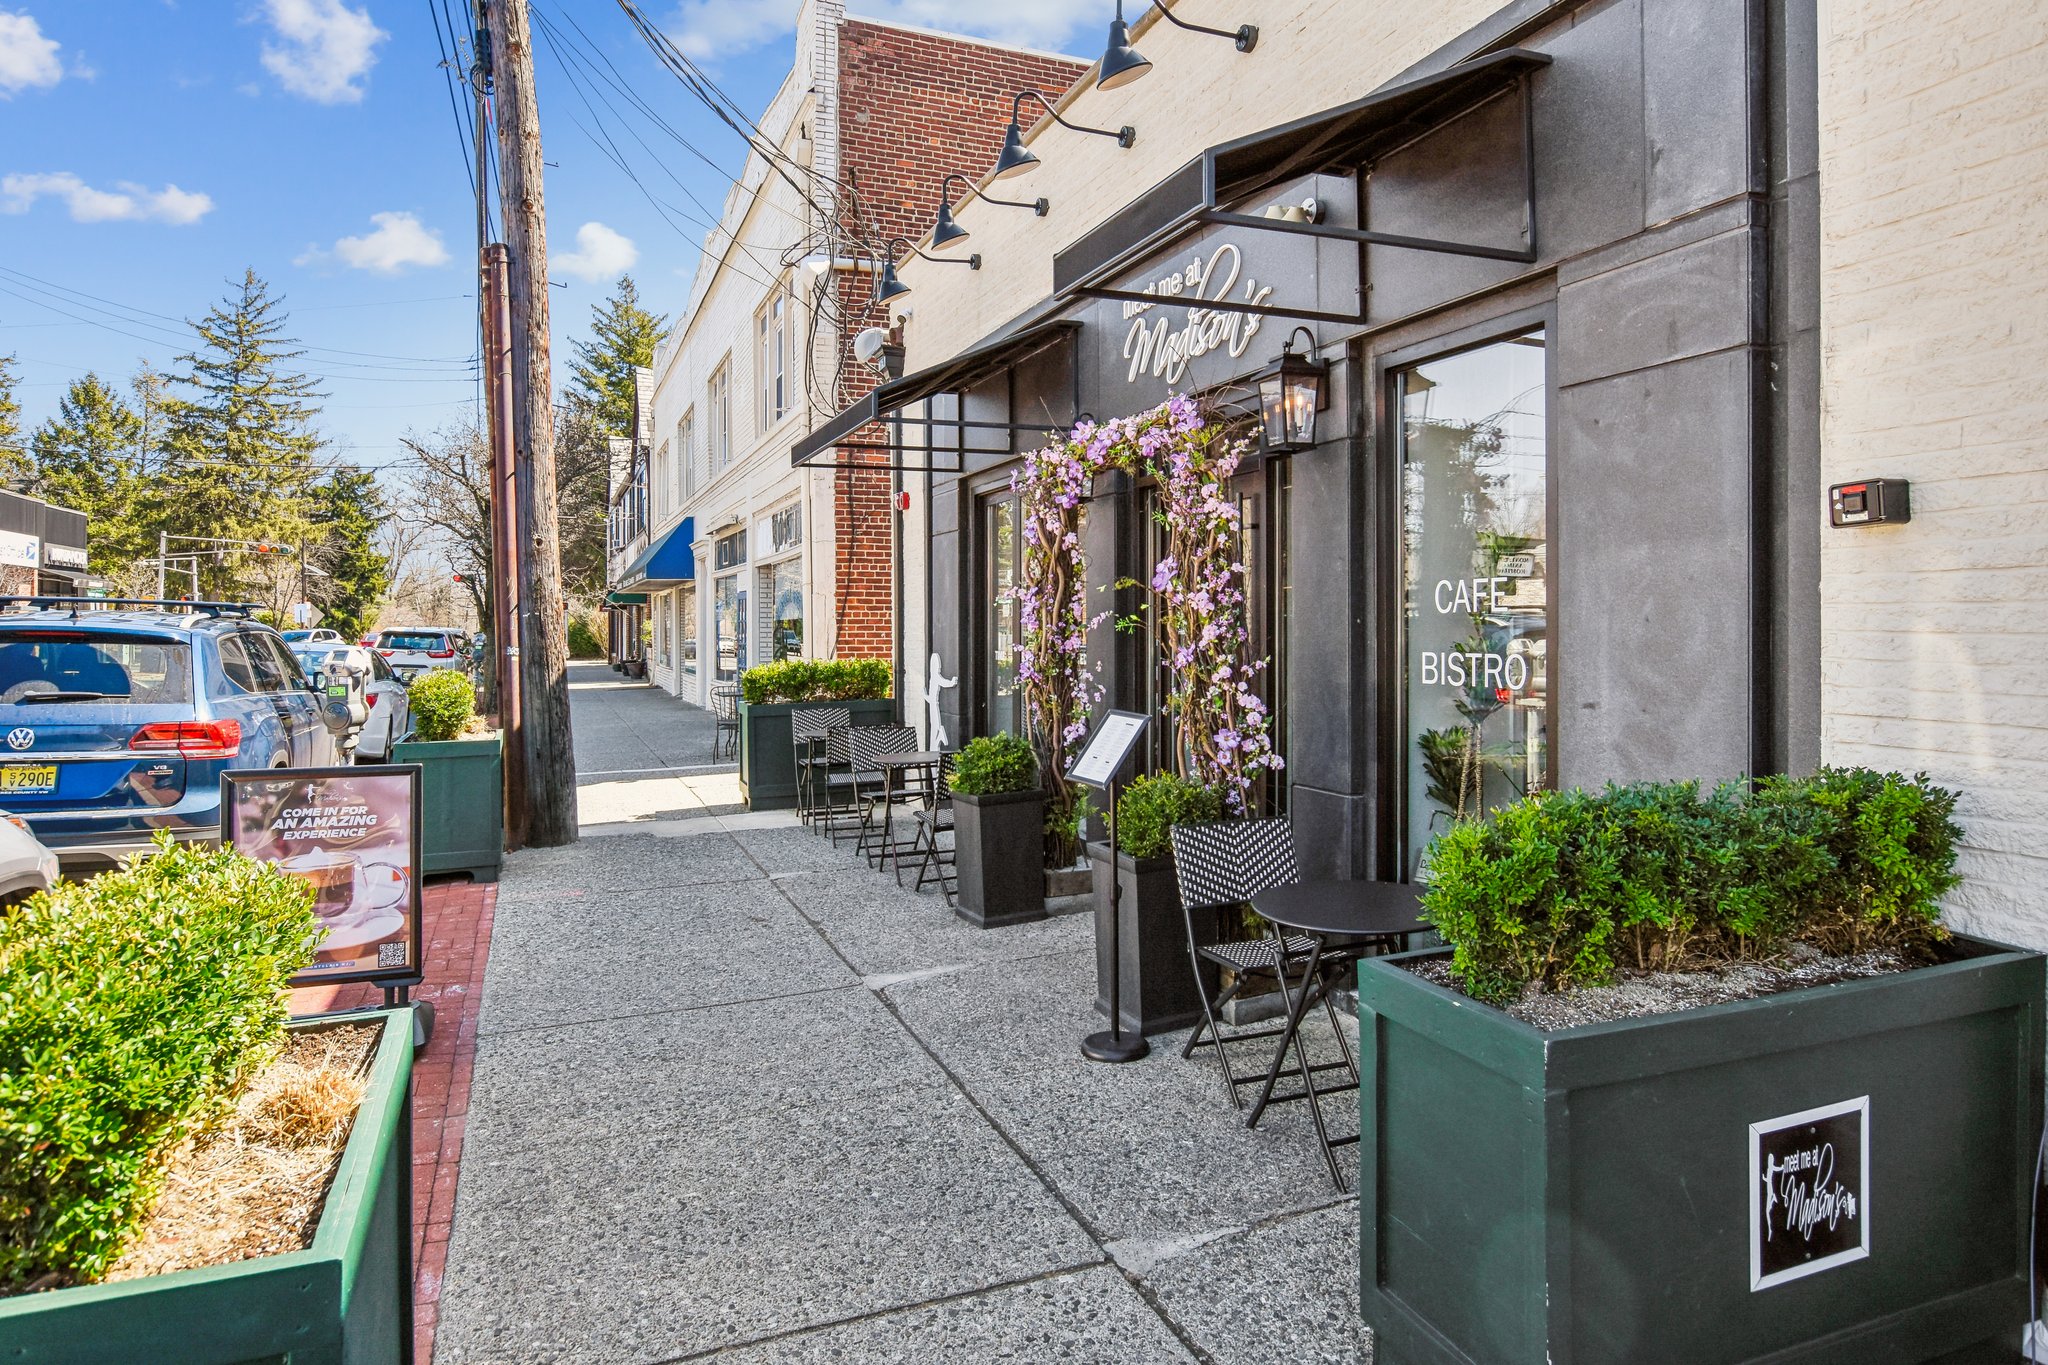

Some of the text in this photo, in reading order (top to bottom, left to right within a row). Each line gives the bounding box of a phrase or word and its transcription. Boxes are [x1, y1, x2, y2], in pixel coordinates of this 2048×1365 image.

[1158, 272, 1184, 297] me
[1185, 257, 1202, 288] at
[1123, 243, 1272, 385] Madison's
[1435, 576, 1509, 614] CAFE
[1421, 651, 1528, 691] BISTRO
[18, 771, 55, 787] 290E
[271, 814, 378, 831] AN AMAZING
[282, 805, 368, 819] COME IN FOR
[283, 828, 367, 841] EXPERIENCE
[1784, 1145, 1819, 1174] meet me at
[1781, 1142, 1844, 1242] Madison's
